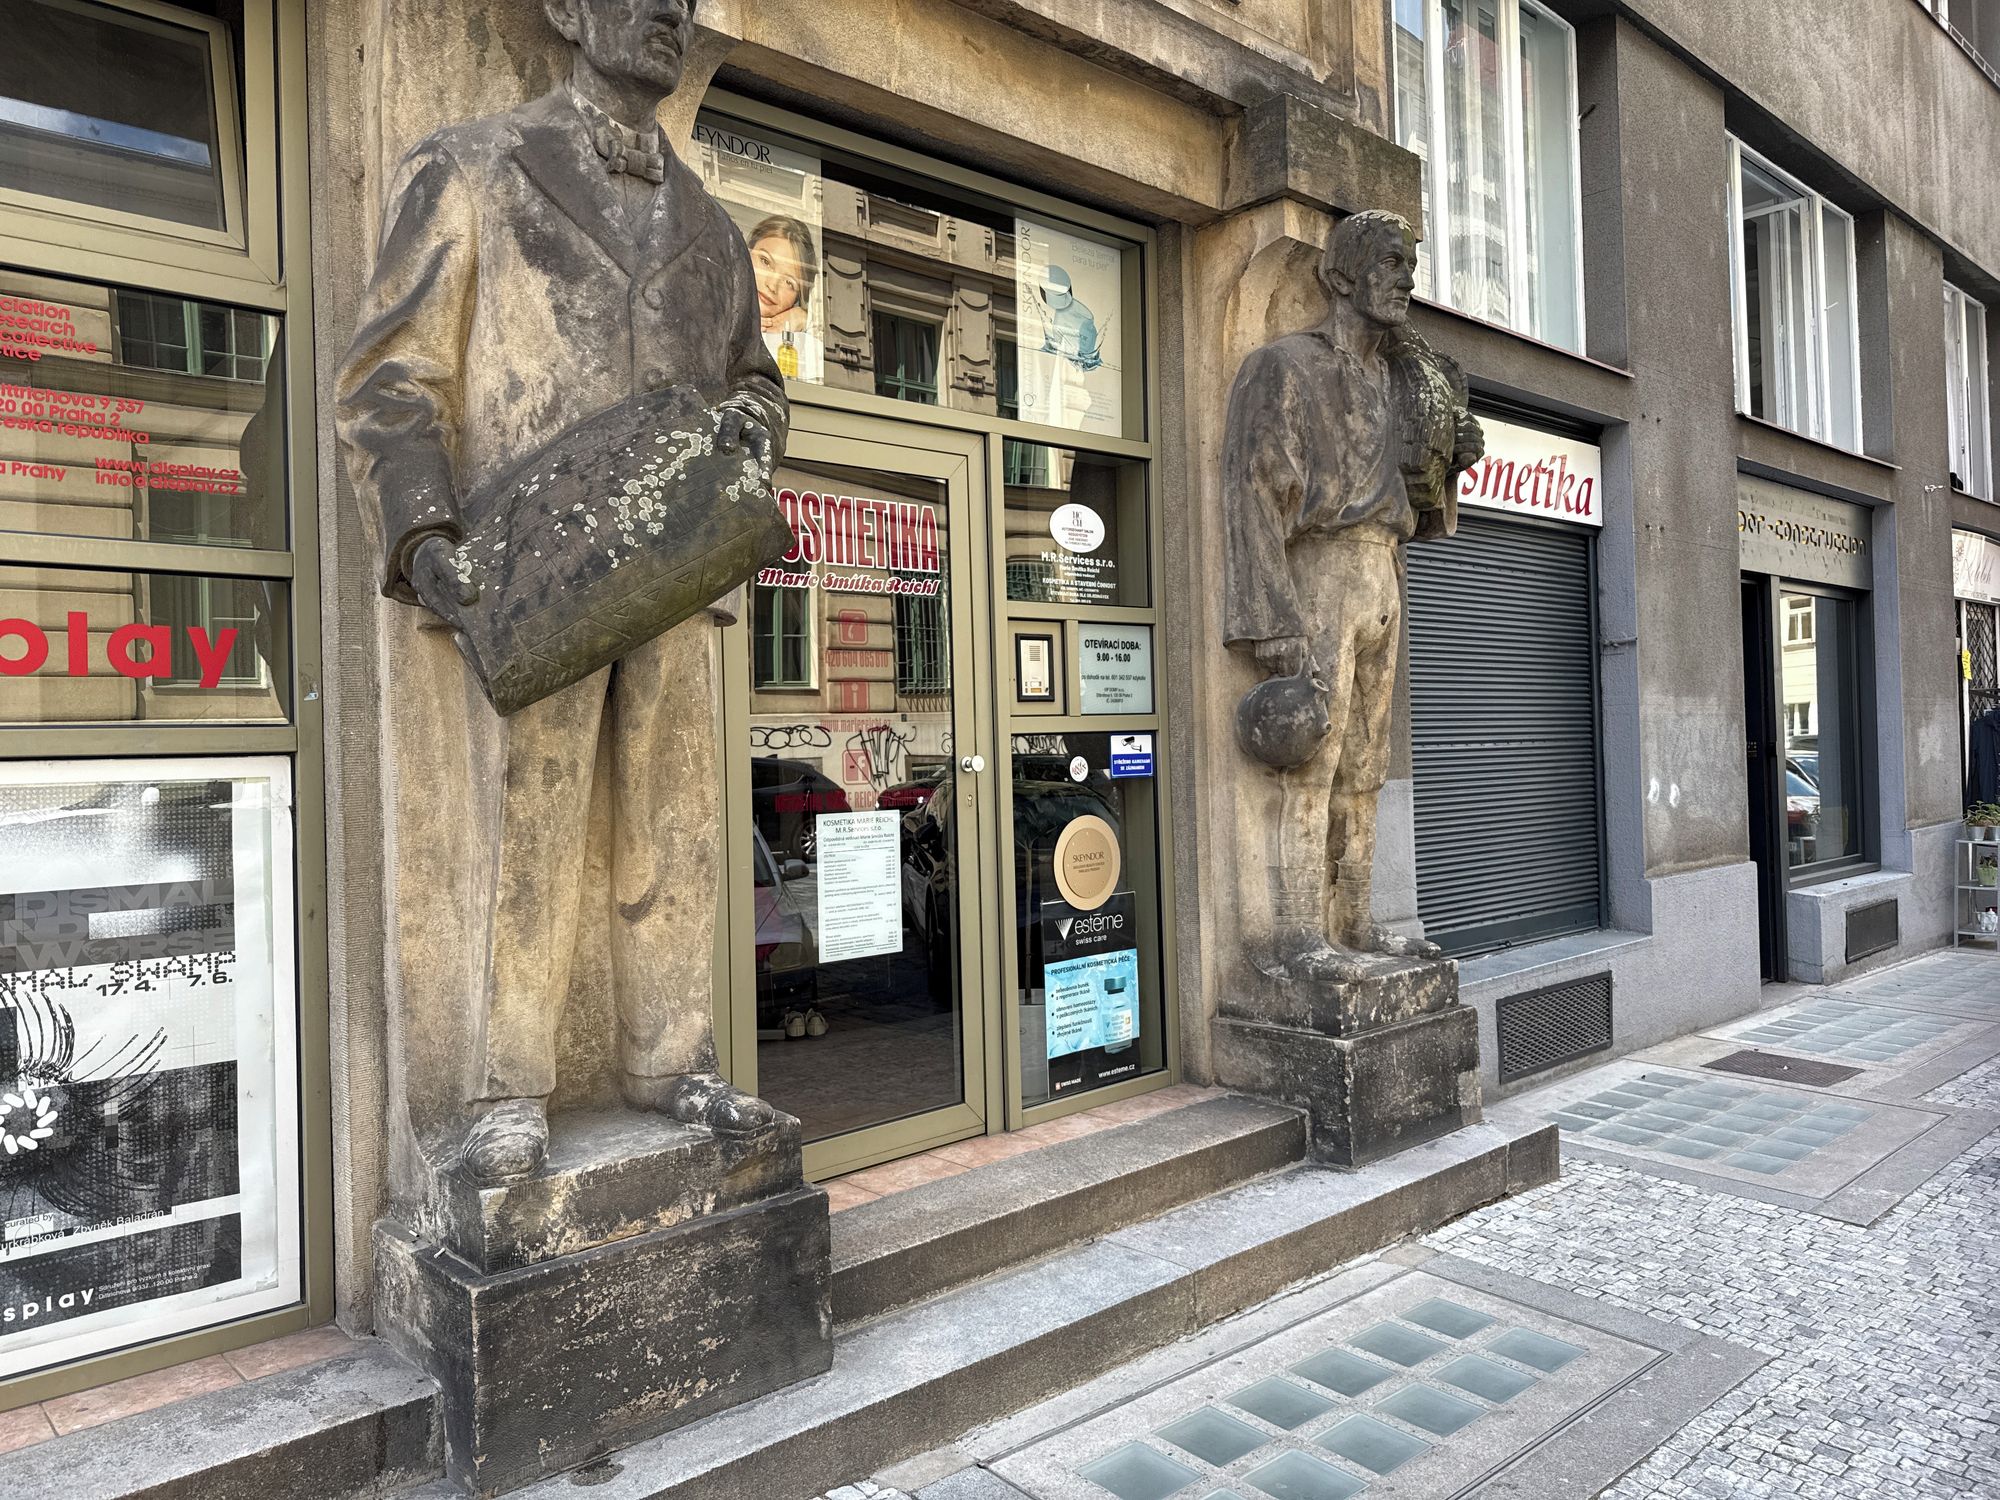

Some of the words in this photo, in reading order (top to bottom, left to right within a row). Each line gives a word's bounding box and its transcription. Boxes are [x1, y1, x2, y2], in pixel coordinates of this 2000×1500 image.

[691, 124, 772, 165] EYNDOR
[0, 328, 97, 355] collective
[0, 343, 42, 361] tice
[21, 401, 45, 417] 00
[49, 404, 106, 425] Praha
[109, 412, 121, 427] 2
[115, 397, 145, 414] 337
[57, 421, 151, 444] republika
[12, 461, 67, 482] Prahy
[95, 456, 240, 481] www.display.cz
[95, 471, 240, 495] info@display.cz
[772, 487, 941, 574] OSMETIKA
[756, 567, 820, 589] Marie
[885, 575, 941, 596] Reichl
[1084, 637, 1120, 650] OTEVÍRACÍ
[1121, 640, 1142, 650] DOBA:
[1096, 652, 1110, 662] 9.00
[1115, 652, 1131, 662] 16.00
[823, 818, 855, 827] KOSMETIKA
[1075, 935, 1092, 946] swiss
[1093, 934, 1108, 943] care
[0, 966, 93, 995] MAL
[110, 950, 236, 983] SWAMP
[5, 1213, 40, 1229] curated
[42, 1212, 54, 1223] by
[116, 1208, 164, 1226] Baladrán
